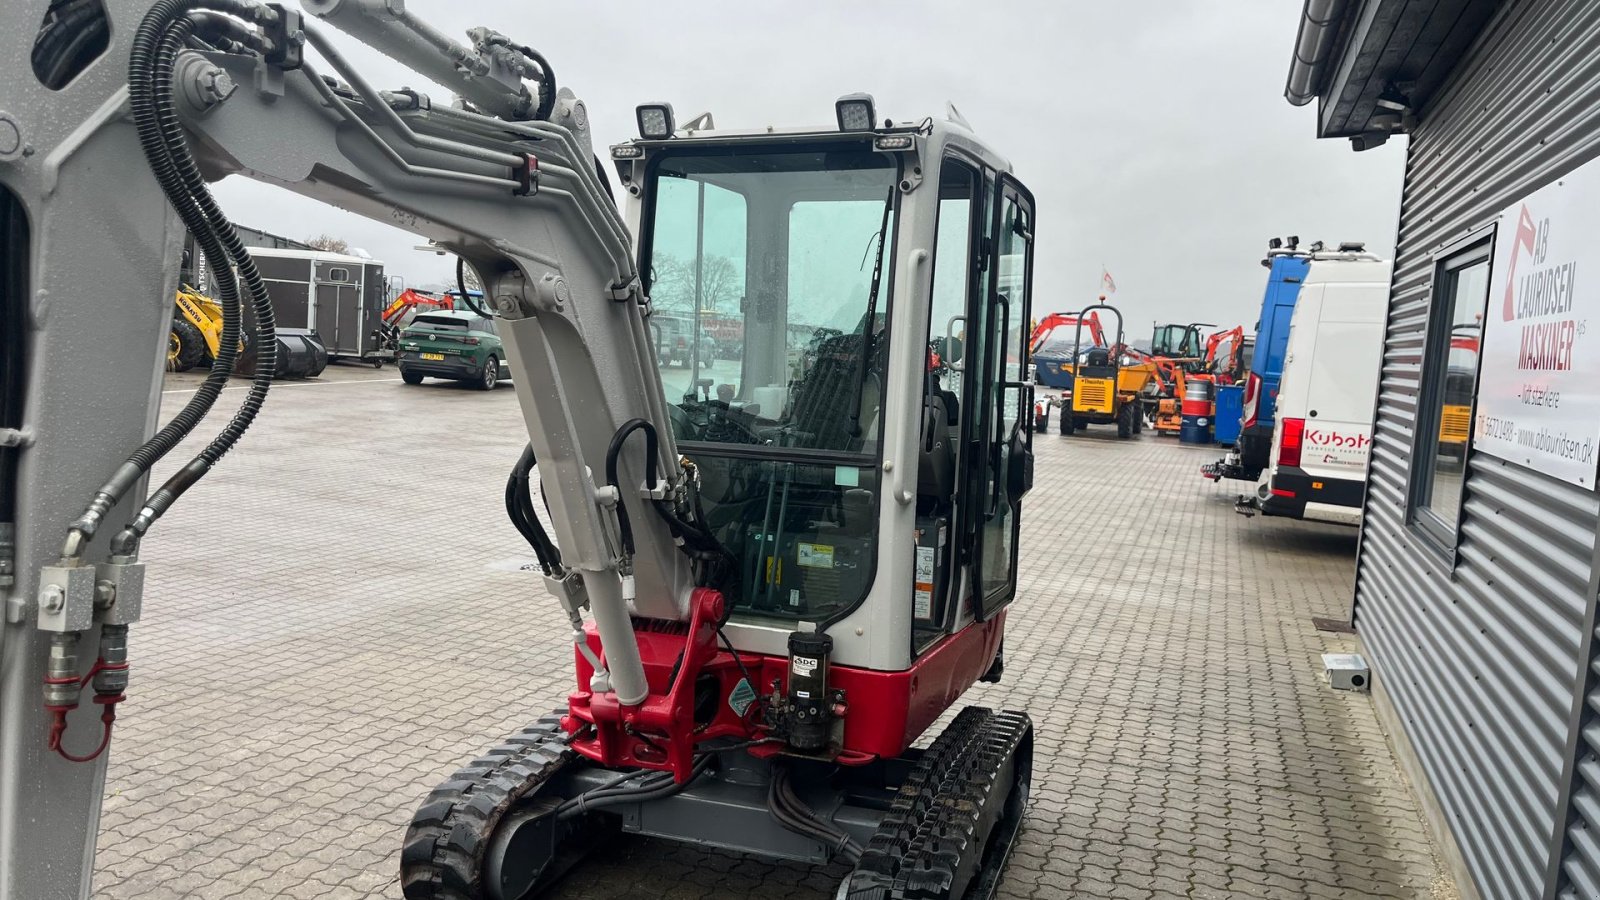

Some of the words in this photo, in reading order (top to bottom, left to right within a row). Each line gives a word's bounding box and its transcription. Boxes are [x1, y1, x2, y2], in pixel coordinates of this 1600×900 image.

[1533, 217, 1550, 266] AB
[179, 296, 202, 323] KOMATSU
[1517, 260, 1576, 320] LAURIDSEN
[1518, 319, 1575, 371] MASKINER
